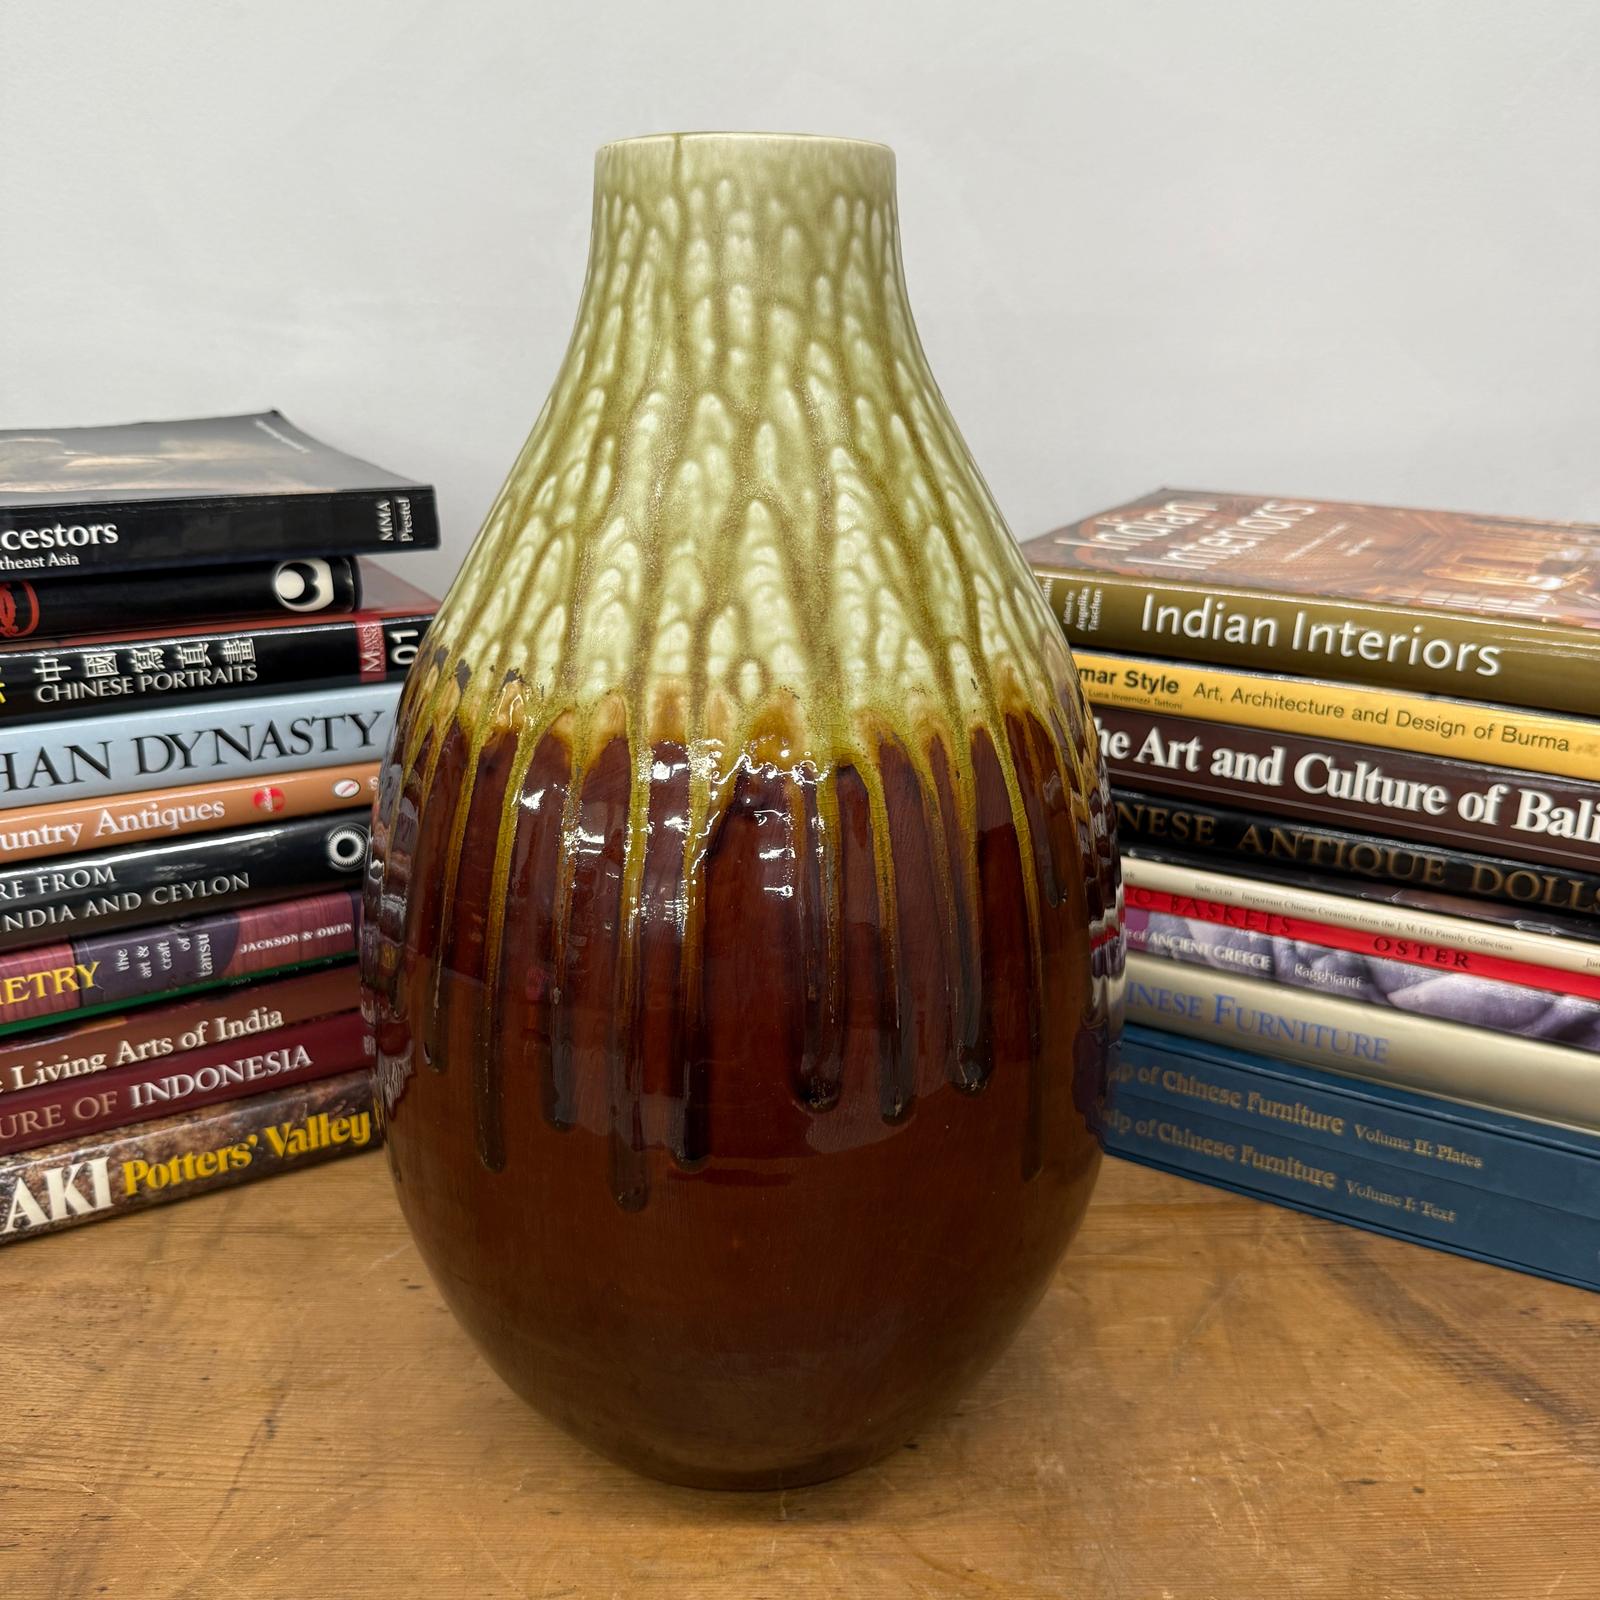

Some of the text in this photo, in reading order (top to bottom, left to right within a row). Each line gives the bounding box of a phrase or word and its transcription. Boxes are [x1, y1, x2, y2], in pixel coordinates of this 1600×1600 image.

[0, 523, 118, 550] cestors
[377, 500, 394, 541] MMA
[398, 496, 414, 541] Prestel
[1054, 501, 1219, 551] Indian
[1124, 500, 1318, 571] Interiors
[48, 552, 80, 567] Asia
[1141, 592, 1502, 678] Indian Interiors
[35, 676, 135, 704] CHINESE
[140, 663, 258, 693] PORTRAITS
[1079, 667, 1117, 686] mar
[1124, 670, 1180, 694] Style
[1193, 682, 1224, 703] Art,
[1231, 687, 1345, 718] Architecture
[1351, 707, 1389, 724] and
[1396, 709, 1466, 739] Design
[1474, 722, 1495, 741] of
[1501, 725, 1569, 752] Burma
[131, 710, 385, 776] DYNASTY
[1133, 726, 1203, 773] Art
[1210, 745, 1287, 787] and
[1294, 751, 1449, 816] Culture
[1457, 783, 1510, 826] of
[1511, 788, 1600, 845] Bali
[94, 801, 225, 837] Antiques
[1238, 823, 1448, 886] ANTIQUE
[0, 871, 250, 933] NDIA AND CEYLON
[37, 865, 117, 895] FROM
[177, 937, 190, 951] of
[239, 922, 352, 954] JACKSON & OWEN
[1170, 894, 1290, 934] BASKETS
[1373, 936, 1471, 968] OSTER
[1242, 892, 1282, 908] Important
[1284, 900, 1317, 914] Chinese
[1318, 906, 1358, 921] Ceramics
[1381, 917, 1396, 929] the
[1418, 926, 1434, 937] Hu
[1435, 929, 1465, 943] Family
[1467, 935, 1514, 951] Collection
[114, 948, 130, 972] the
[136, 944, 152, 979] art &
[157, 940, 171, 970] craft
[197, 933, 213, 978] tansu
[1150, 930, 1212, 957] ANCIENT
[1213, 945, 1272, 971] GREECE
[0, 961, 100, 1005] ETRY
[10, 1053, 107, 1091] Living
[115, 1037, 172, 1067] Arts
[178, 1020, 209, 1050] of
[213, 1006, 284, 1043] India
[1213, 993, 1390, 1064] FURNITURE
[73, 1091, 118, 1119] OF
[128, 1044, 314, 1110] INDONESIA
[1137, 1066, 1160, 1085] of
[1162, 1070, 1243, 1109] Chinese
[1247, 1090, 1345, 1137] Furniture
[1354, 1123, 1411, 1151] Volume
[1437, 1144, 1484, 1169] Plates
[0, 1156, 115, 1234] AKI
[265, 1110, 371, 1158] Valley
[1135, 1118, 1158, 1138] of
[1157, 1122, 1236, 1161] Chinese
[1240, 1144, 1337, 1191] Furniture
[1345, 1179, 1402, 1208] Volume
[1420, 1199, 1457, 1224] Text
